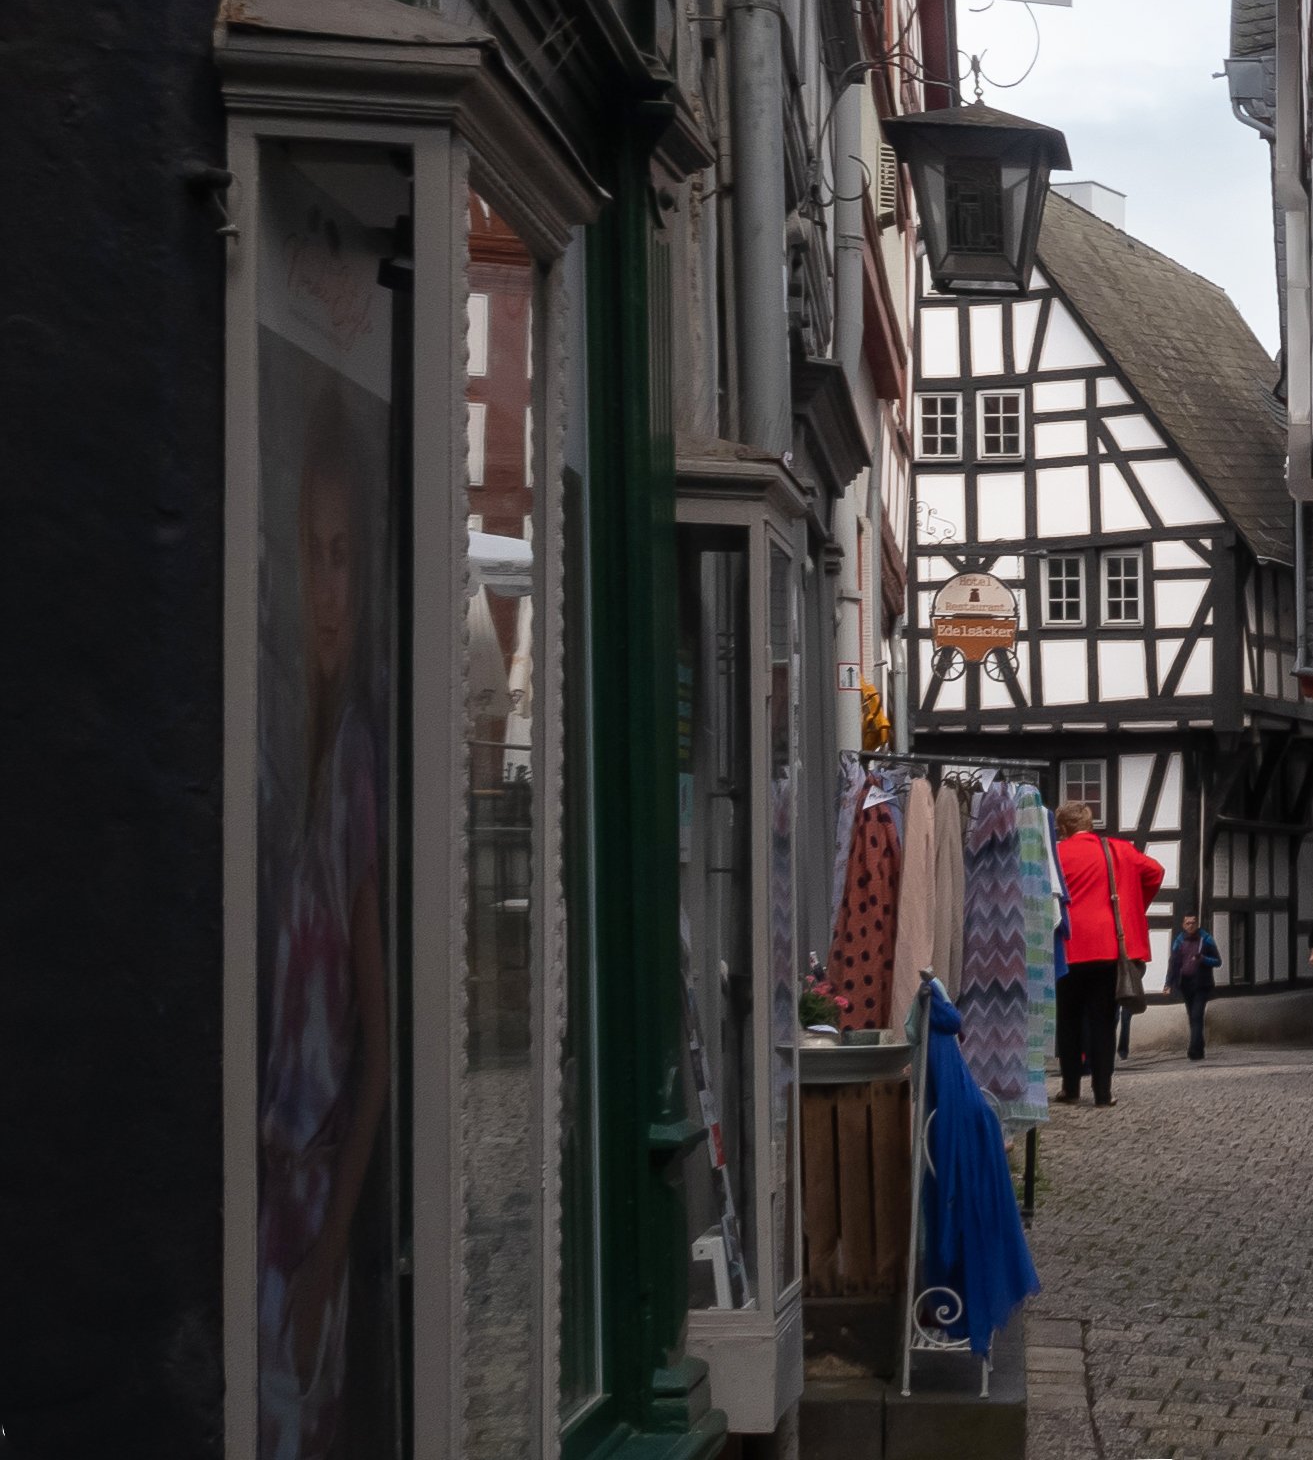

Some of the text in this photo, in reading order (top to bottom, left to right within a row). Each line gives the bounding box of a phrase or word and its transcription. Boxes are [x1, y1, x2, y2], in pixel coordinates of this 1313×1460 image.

[960, 578, 992, 586] Hotel
[945, 602, 1006, 612] Restaurant
[937, 624, 1013, 637] Edelsäcker
